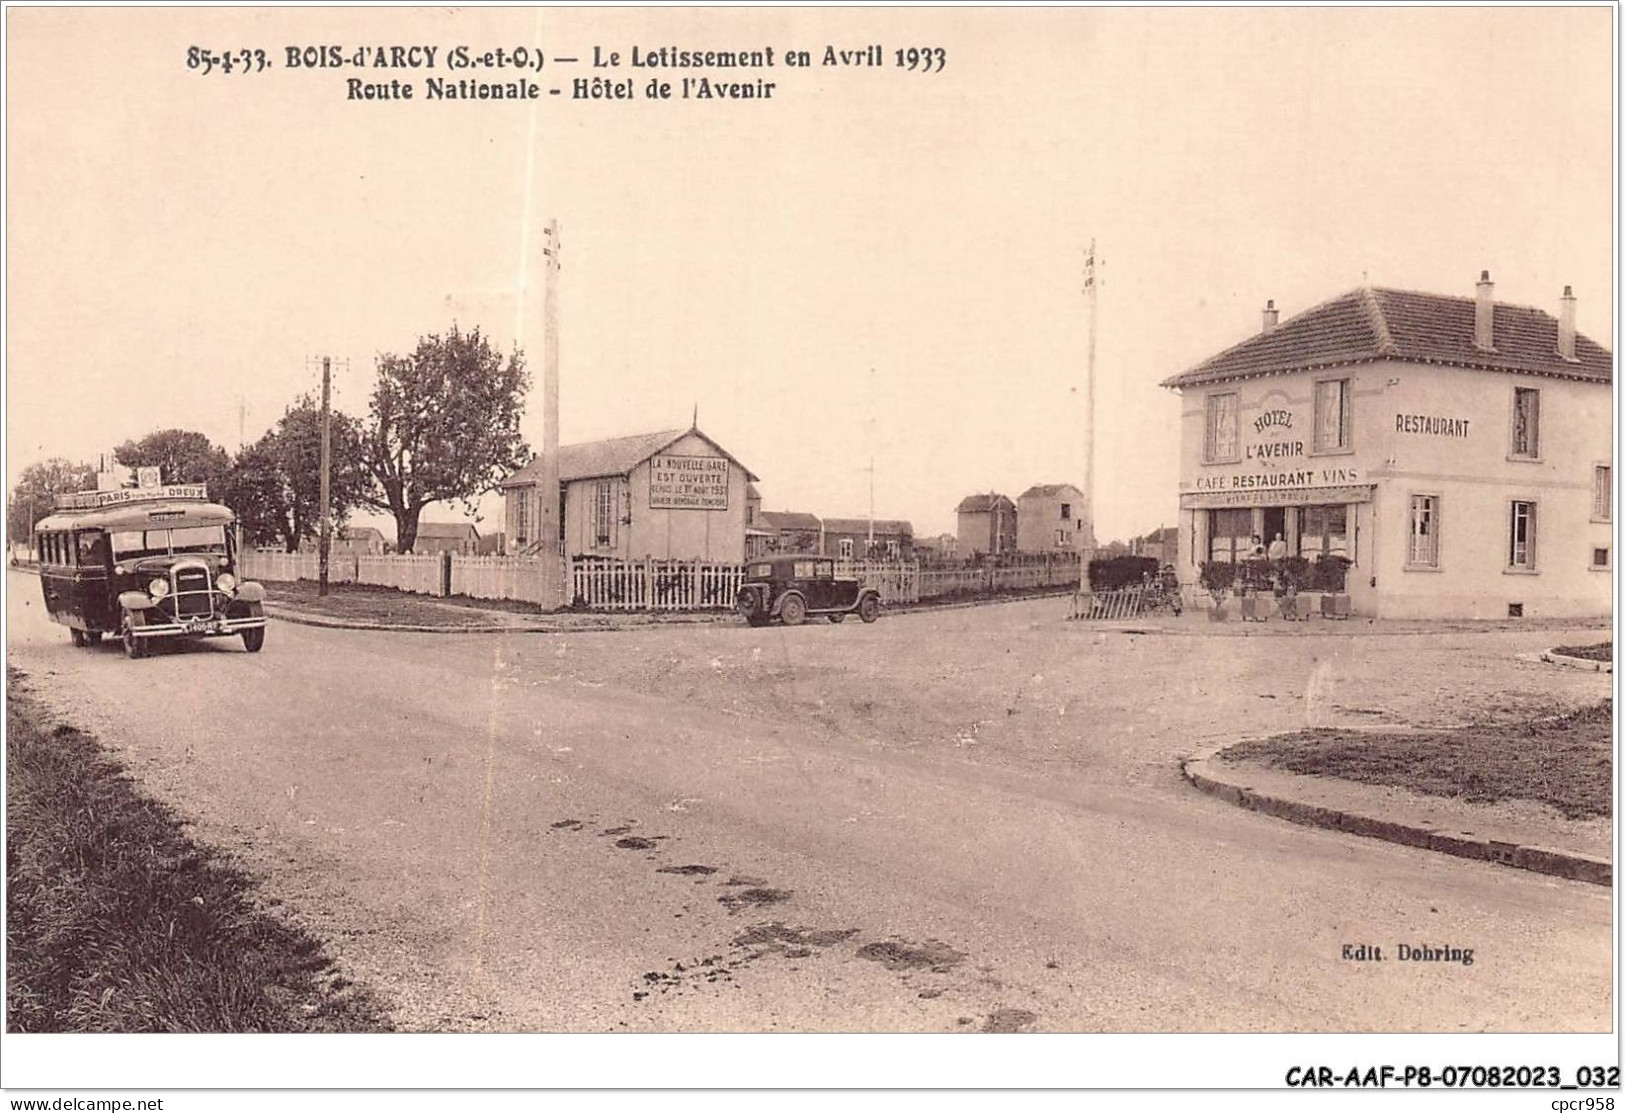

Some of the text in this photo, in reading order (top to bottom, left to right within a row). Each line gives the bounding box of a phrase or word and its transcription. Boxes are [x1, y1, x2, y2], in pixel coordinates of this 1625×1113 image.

[1254, 410, 1293, 434] HOTEL
[1396, 414, 1469, 438] RESTAURANT
[1246, 441, 1303, 459] L'AVENIR
[652, 459, 726, 471] LA NOUVELLE GARE
[657, 473, 721, 483] EST OUVERTE
[1233, 471, 1314, 488] RESTAURANT
[1323, 469, 1358, 483] VINS
[99, 491, 131, 505] PARIS
[169, 488, 204, 497] DREUX
